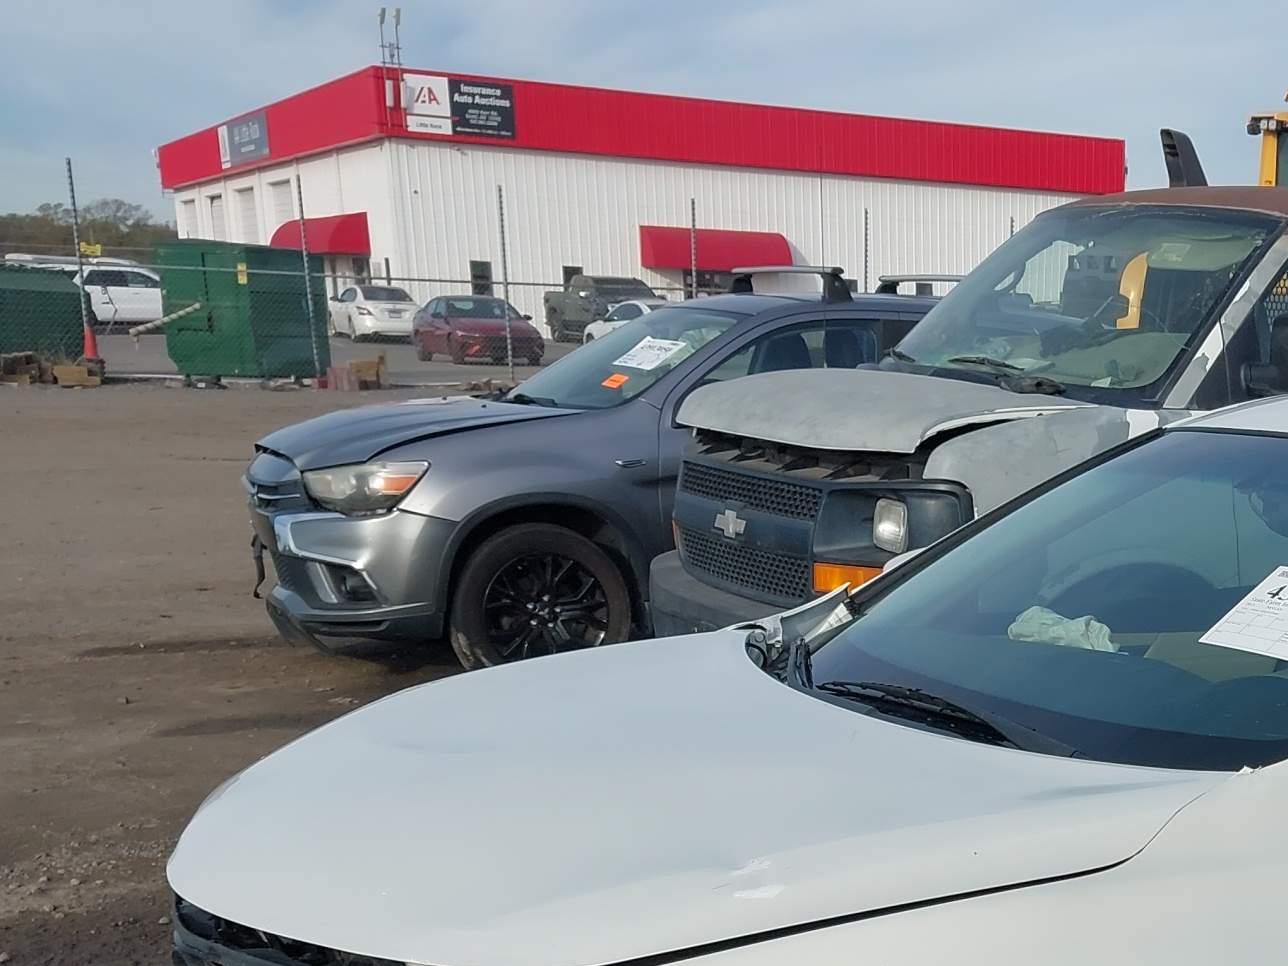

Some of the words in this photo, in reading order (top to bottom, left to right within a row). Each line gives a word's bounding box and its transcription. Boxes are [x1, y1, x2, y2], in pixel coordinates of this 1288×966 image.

[460, 83, 502, 96] Insurance
[453, 92, 473, 103] Auto
[474, 95, 511, 107] Auctions
